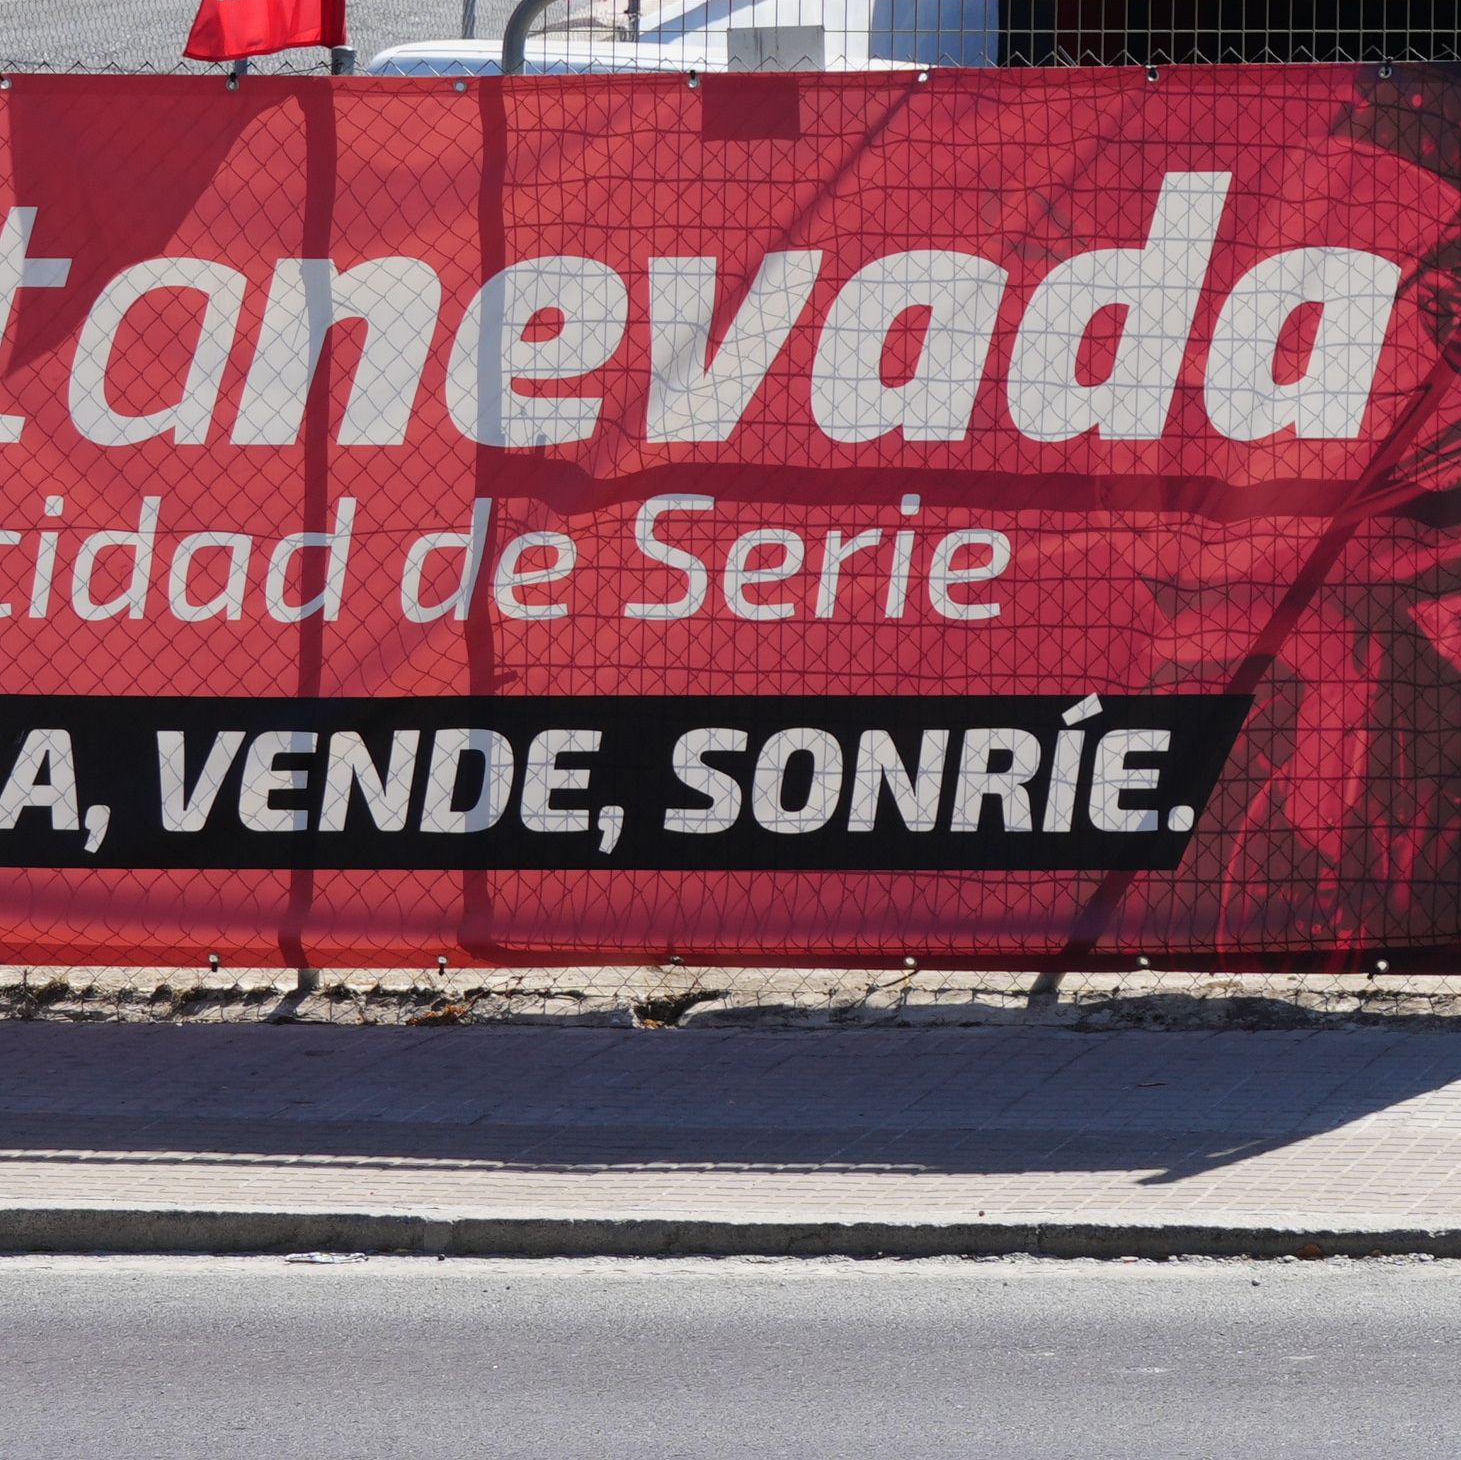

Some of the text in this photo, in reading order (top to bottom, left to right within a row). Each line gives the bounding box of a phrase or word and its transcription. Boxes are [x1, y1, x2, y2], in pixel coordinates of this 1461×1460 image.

[401, 497, 579, 623] de
[624, 493, 1012, 621] Serie
[156, 728, 626, 854] VENDE,
[663, 692, 1195, 835] SONRÍE.
